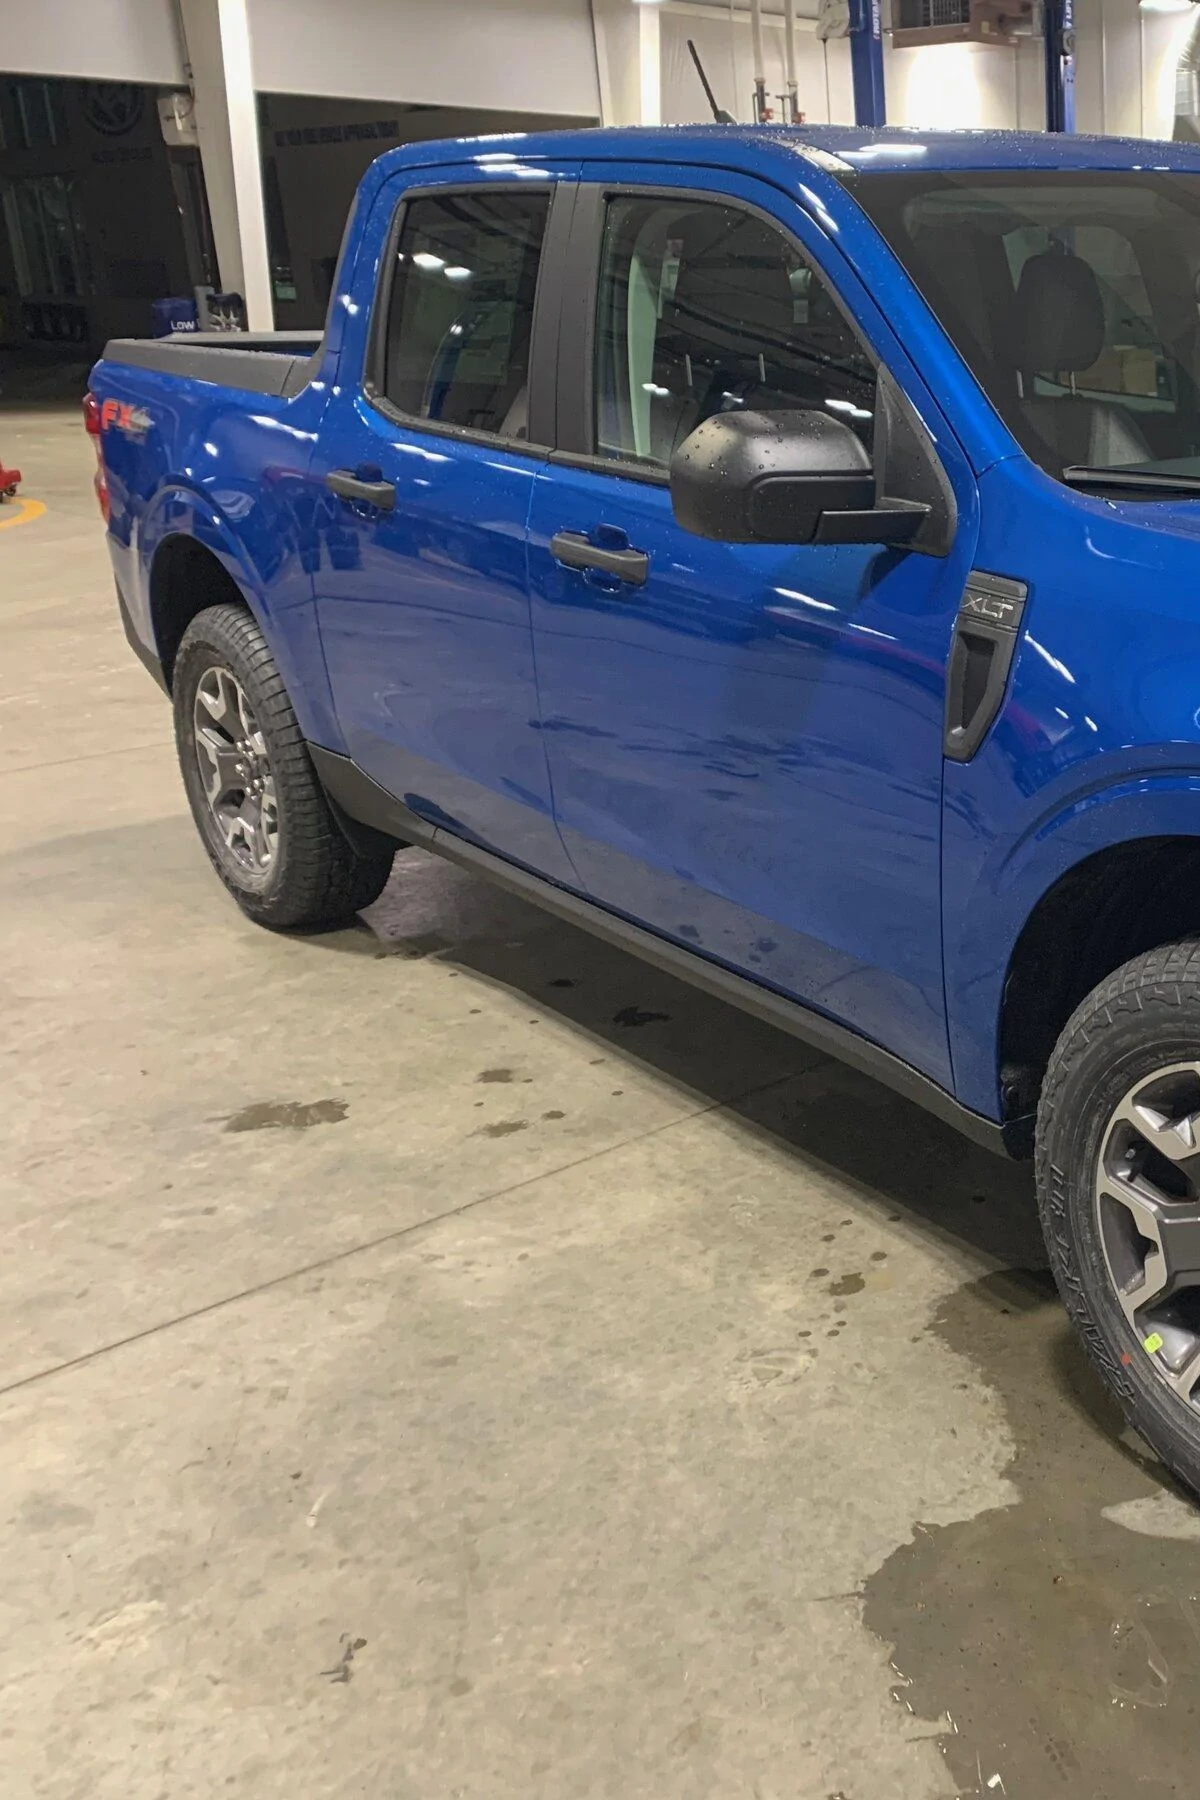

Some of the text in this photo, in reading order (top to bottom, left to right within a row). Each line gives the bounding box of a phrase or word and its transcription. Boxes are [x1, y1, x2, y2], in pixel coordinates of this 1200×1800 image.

[170, 320, 195, 330] LOW
[101, 397, 156, 433] FX4
[962, 594, 1014, 618] XLT
